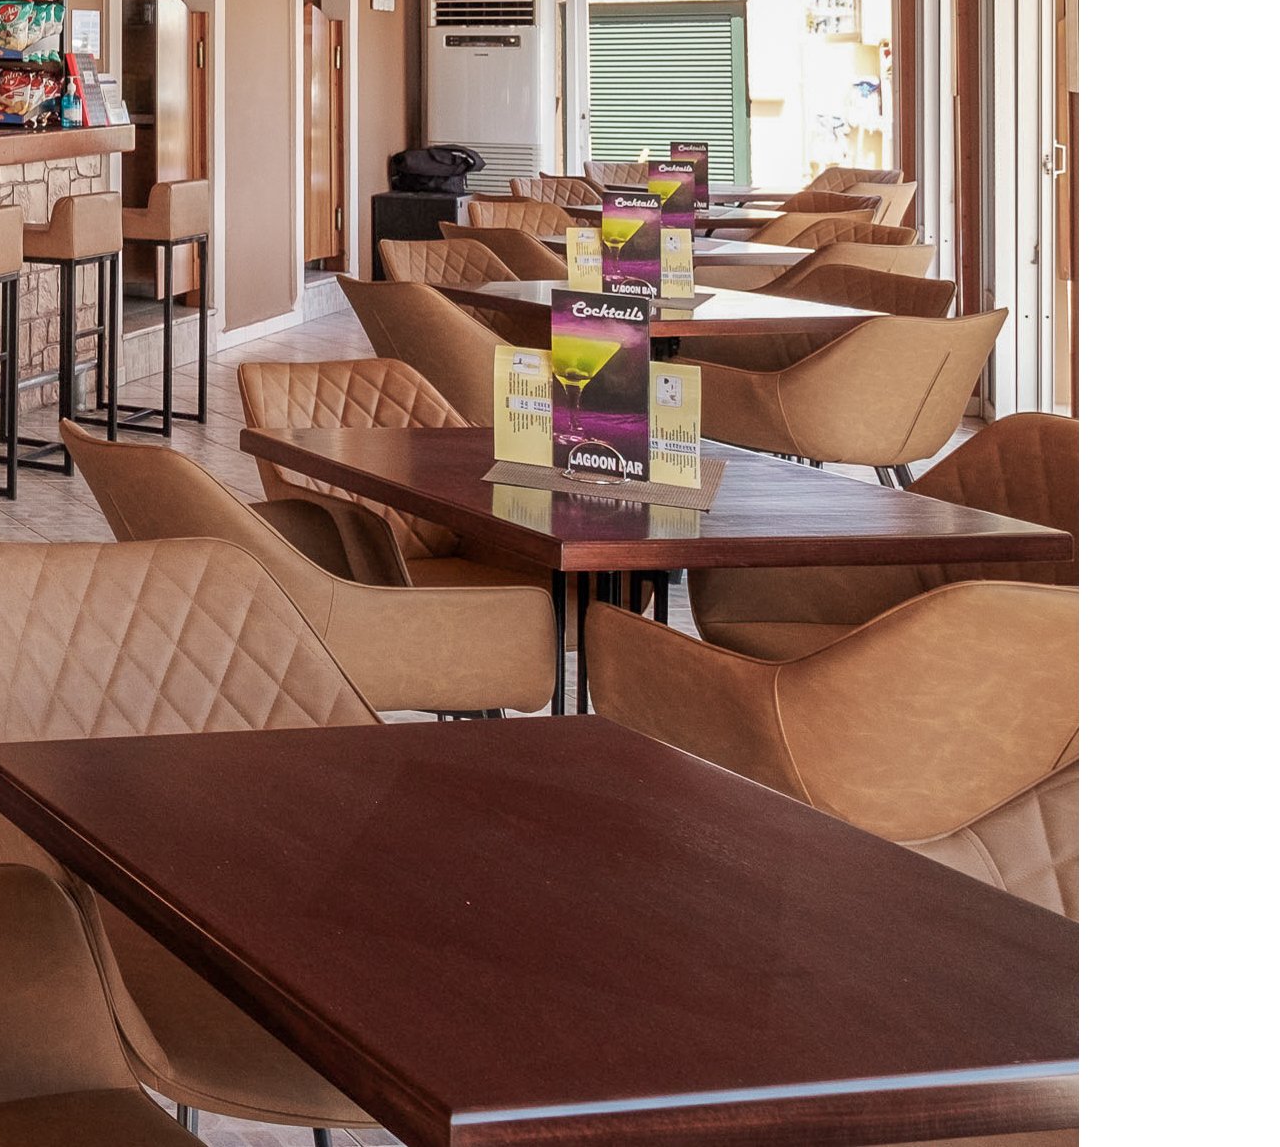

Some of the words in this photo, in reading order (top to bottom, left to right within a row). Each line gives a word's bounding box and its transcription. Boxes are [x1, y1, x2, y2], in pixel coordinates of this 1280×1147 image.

[677, 144, 707, 152] Cocktails
[658, 163, 693, 173] Cocktails
[614, 197, 659, 208] Cocktails
[572, 300, 644, 321] Cocktails
